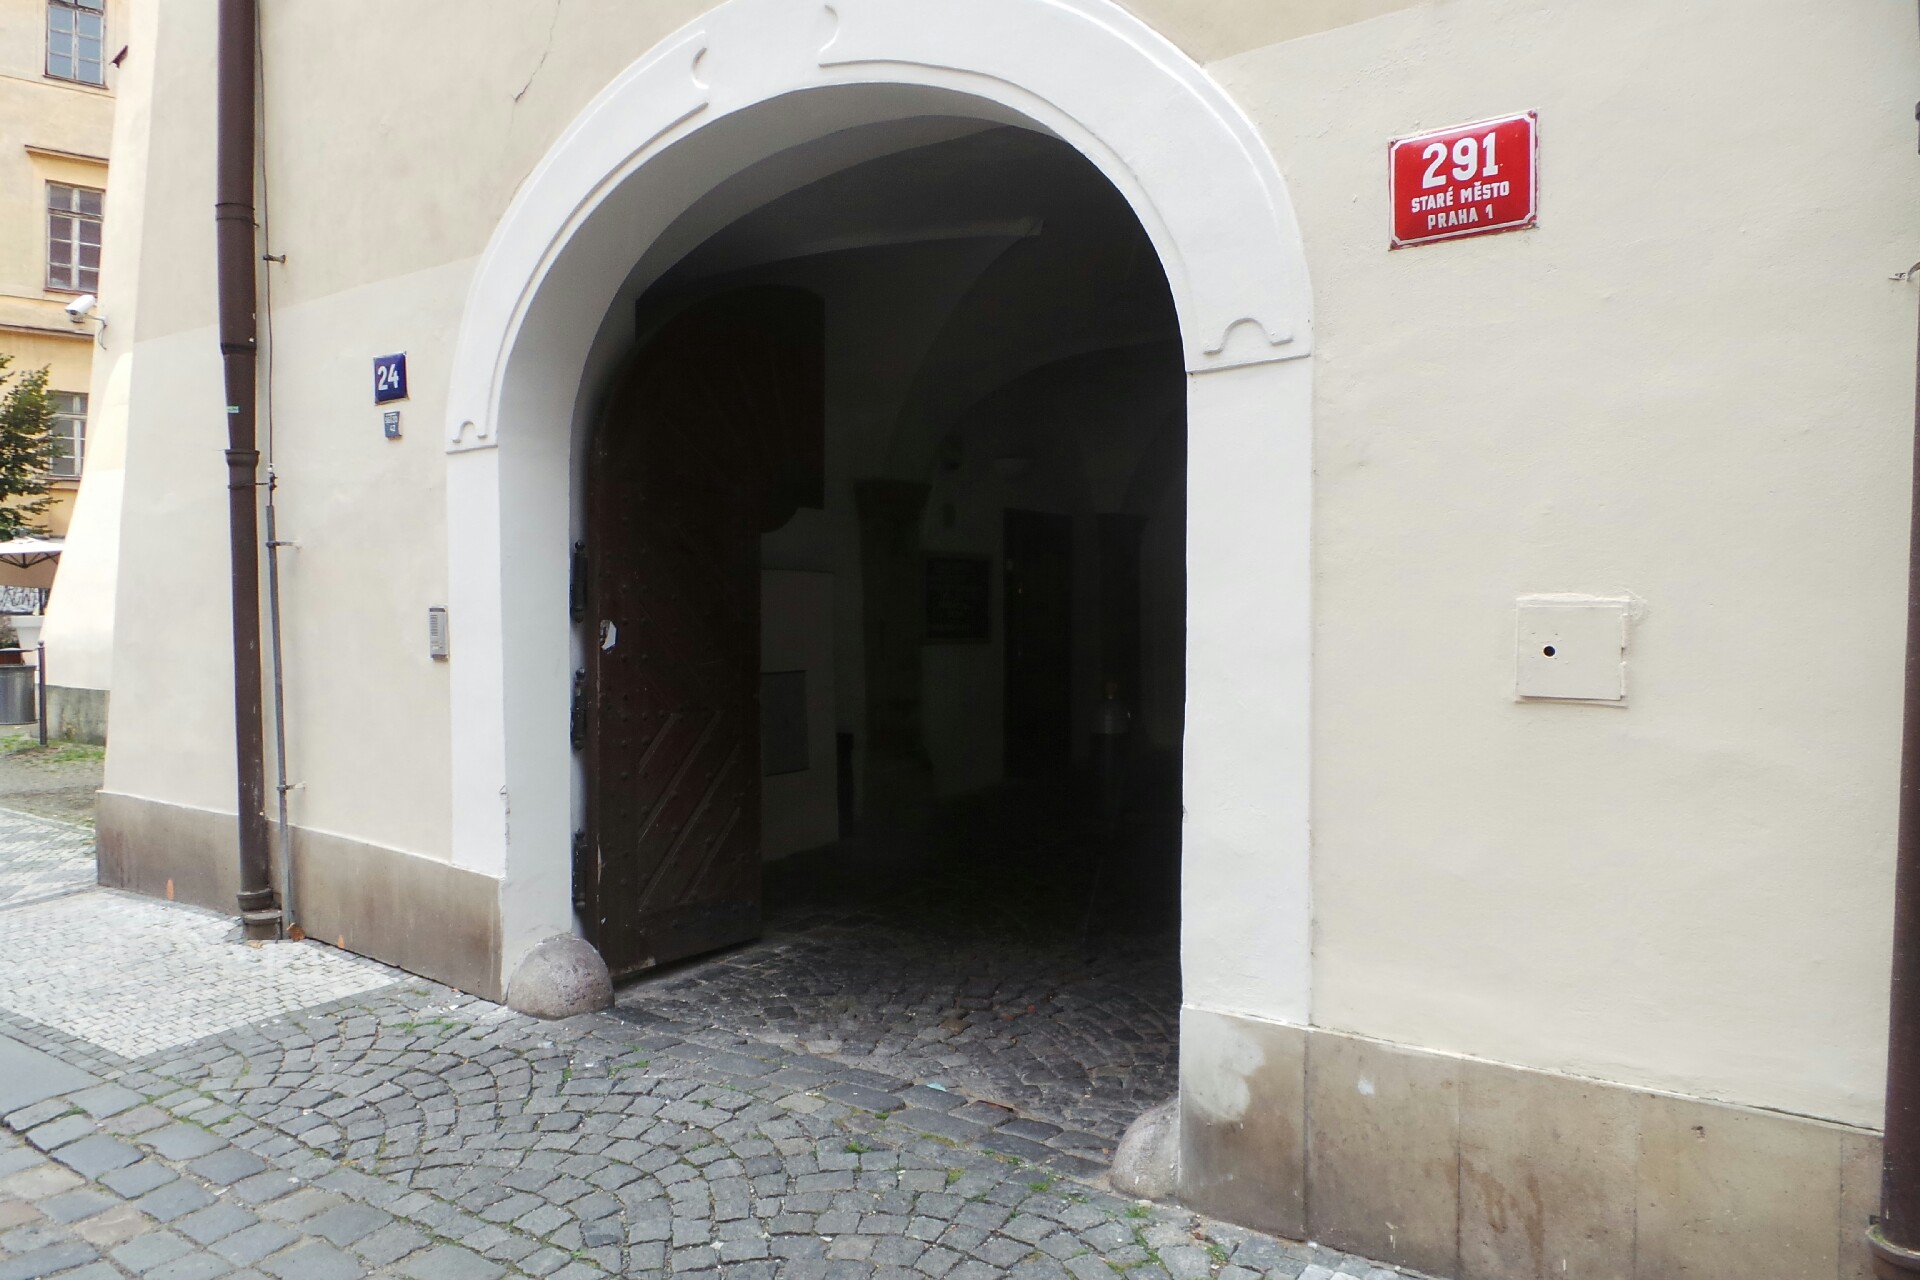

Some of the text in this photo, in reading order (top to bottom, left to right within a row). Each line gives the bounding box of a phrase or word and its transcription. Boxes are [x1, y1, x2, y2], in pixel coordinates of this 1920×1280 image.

[1422, 132, 1499, 189] 291
[1411, 181, 1510, 213] STARÉ MĚSTO
[1428, 204, 1493, 230] PRAHA 1
[378, 364, 399, 390] 24
